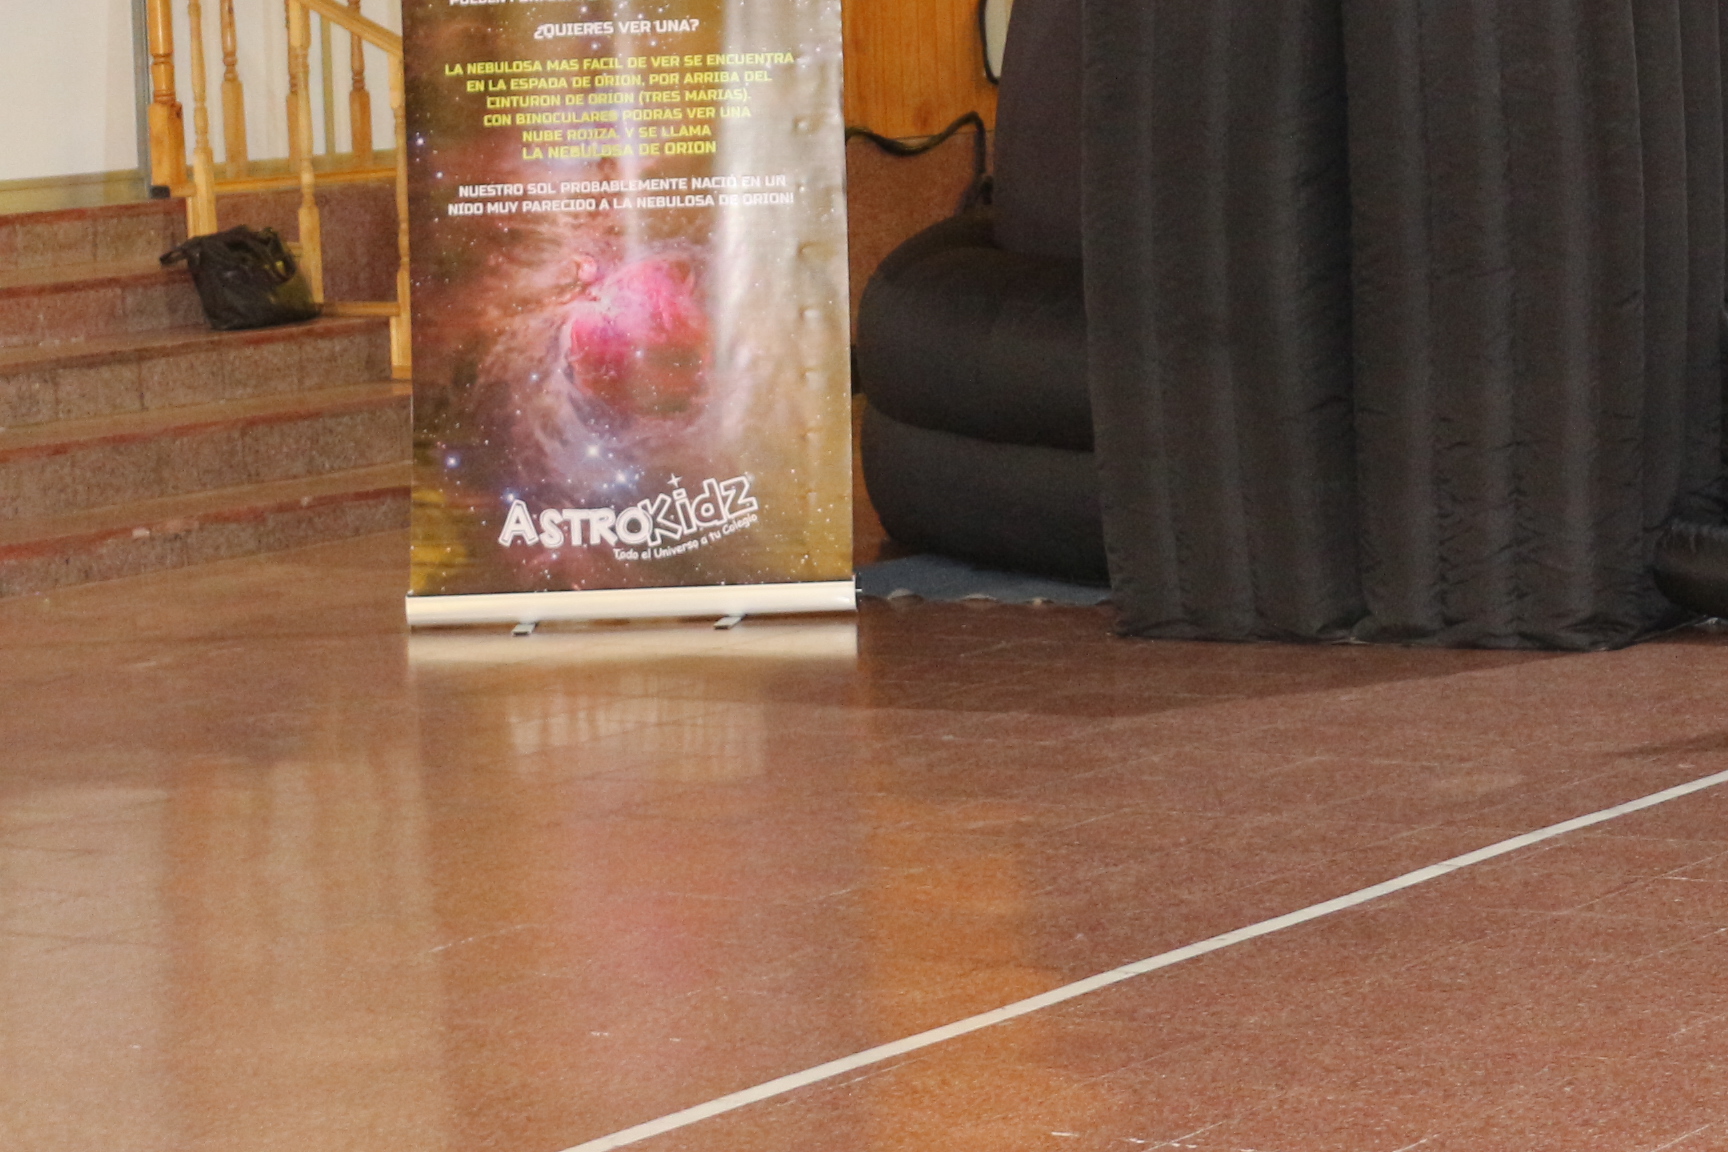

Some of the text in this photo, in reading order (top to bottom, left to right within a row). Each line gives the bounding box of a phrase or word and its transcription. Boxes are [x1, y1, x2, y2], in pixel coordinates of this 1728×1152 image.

[533, 19, 700, 40] ¿QUIERES VER UNA?
[444, 52, 794, 76] LA NEBULOSA MAS FACIL DE VER SE ENCUENTRA
[466, 80, 485, 92] EN
[489, 79, 507, 91] LA
[510, 77, 568, 90] ESPADA
[572, 76, 591, 88] DE
[649, 73, 679, 85] POR
[683, 71, 740, 84] ARRIBA
[744, 70, 772, 82] DEL
[486, 95, 561, 109] CINTURON
[565, 94, 584, 106] DE
[588, 92, 634, 105] ORION
[639, 90, 680, 105] (TRES
[483, 106, 751, 127] CON BINOCULARES PODRAS VER UNA
[522, 130, 563, 142] NUBE
[625, 126, 635, 138] Y
[639, 126, 657, 138] SE
[661, 124, 712, 137] LLAMA
[522, 141, 716, 160] LA NEBULOSA DE ORION
[459, 184, 524, 198] NUESTRO
[527, 182, 556, 195] SOL
[560, 178, 687, 194] PROBABLEMENTE
[742, 175, 761, 187] EN
[765, 174, 786, 186] UN
[448, 192, 794, 216] NIDO MUY PARECIDO A LA NEBULOSA DE ORION!
[613, 513, 758, 560] Todo el Universo a tu Colegio
